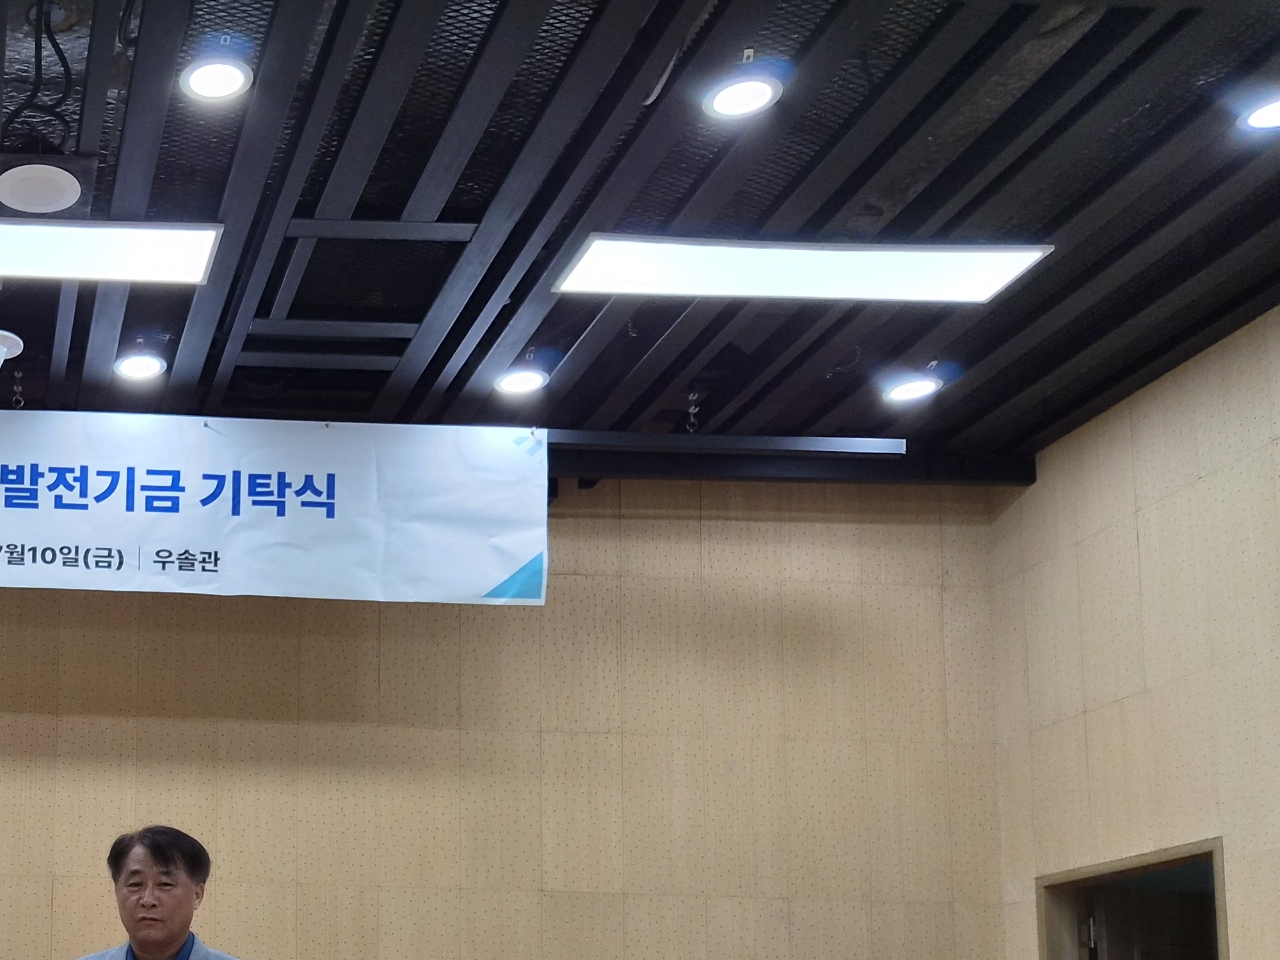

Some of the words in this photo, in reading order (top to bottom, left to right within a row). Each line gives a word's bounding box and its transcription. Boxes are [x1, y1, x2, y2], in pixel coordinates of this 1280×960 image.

[0, 463, 186, 513] 발전기금
[199, 470, 338, 519] 기탁식
[153, 548, 221, 573] 우솔관
